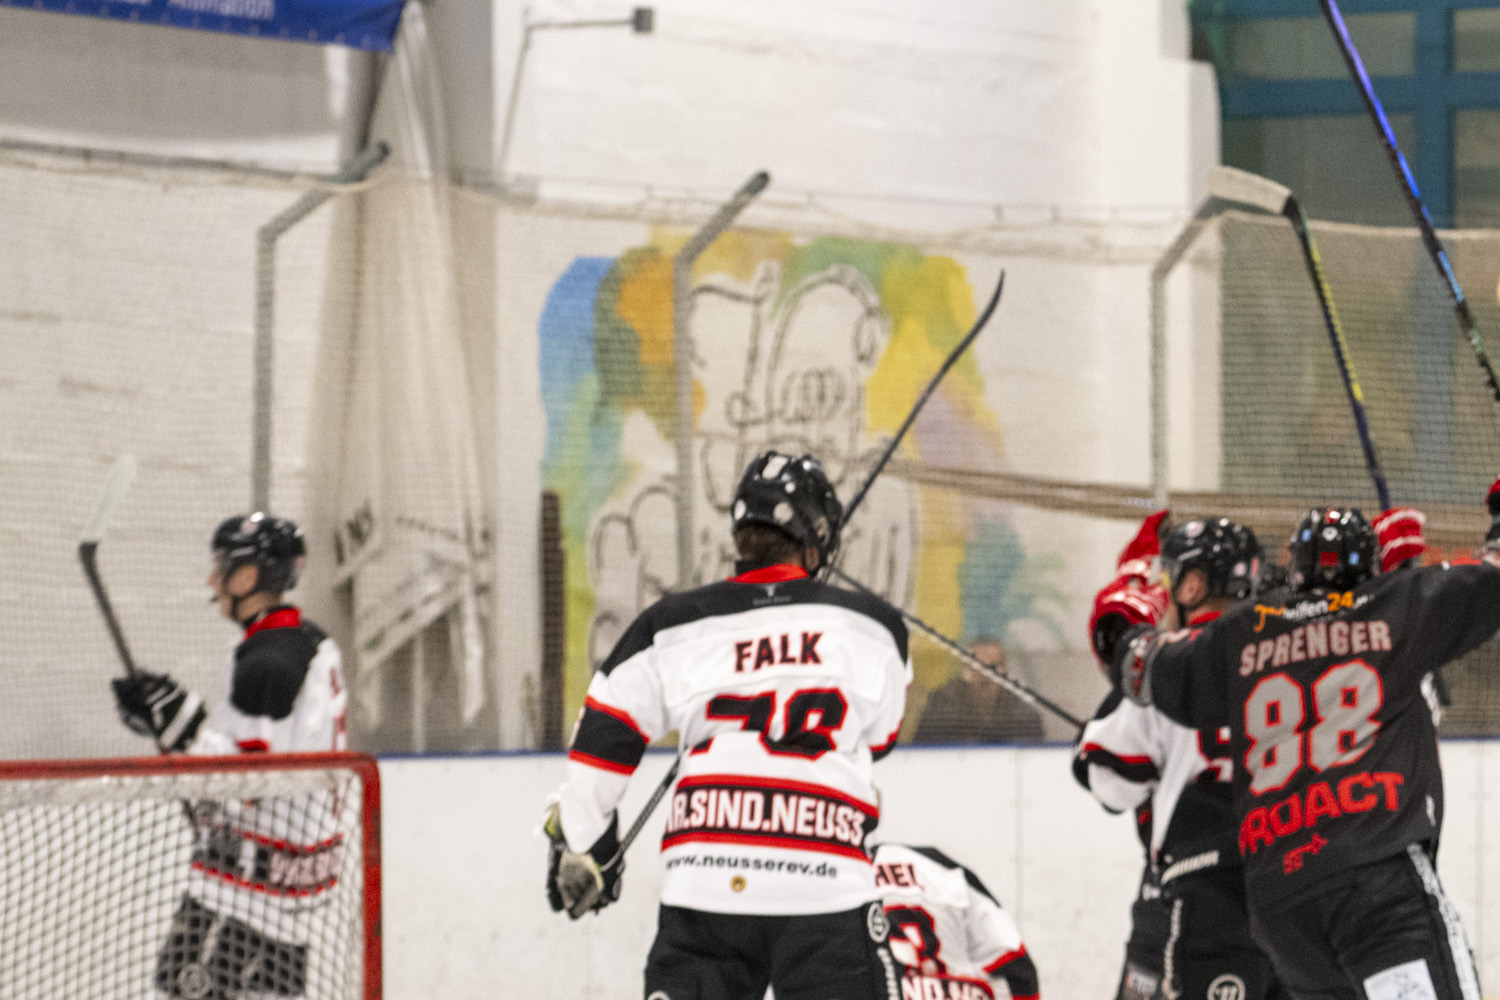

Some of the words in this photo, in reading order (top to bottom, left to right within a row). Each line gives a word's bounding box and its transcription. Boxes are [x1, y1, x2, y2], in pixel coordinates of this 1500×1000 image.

[734, 631, 824, 673] FALK
[1239, 620, 1392, 677] SPRENGER
[1243, 657, 1385, 797] 88
